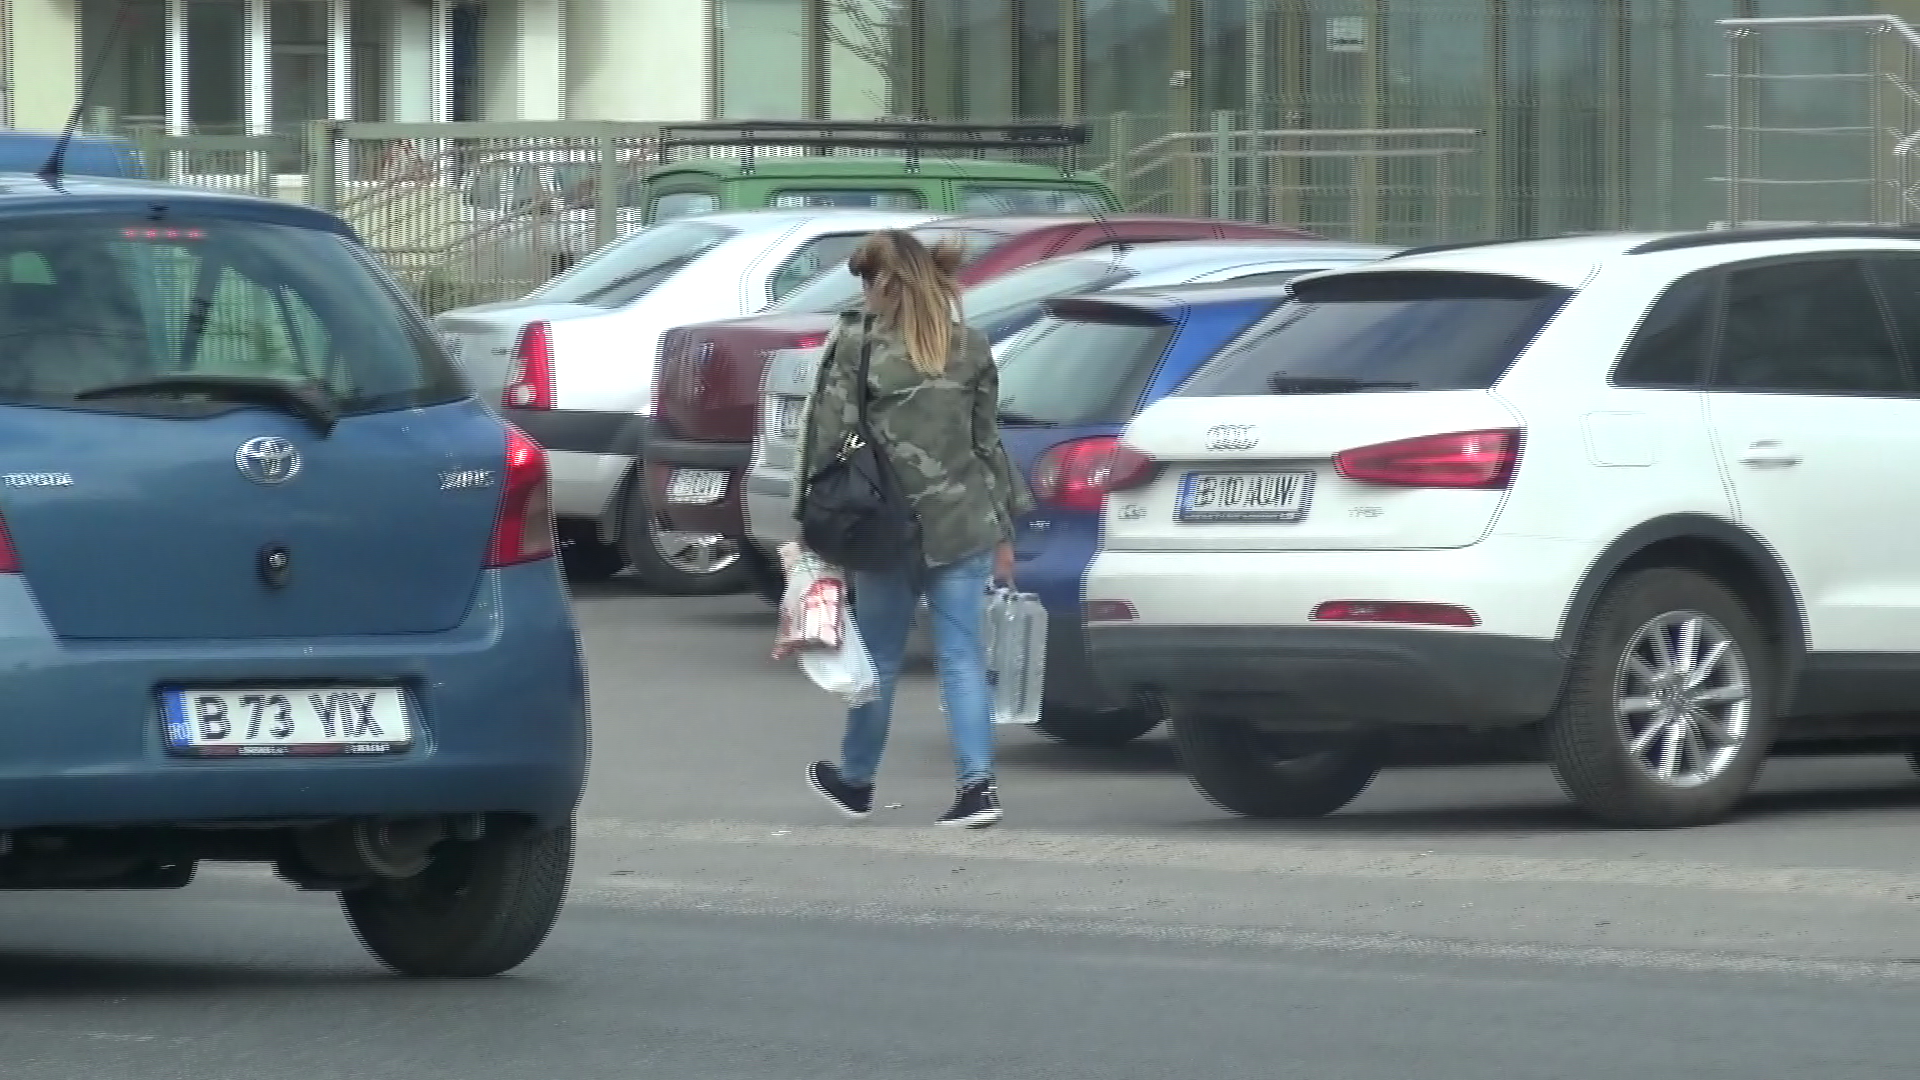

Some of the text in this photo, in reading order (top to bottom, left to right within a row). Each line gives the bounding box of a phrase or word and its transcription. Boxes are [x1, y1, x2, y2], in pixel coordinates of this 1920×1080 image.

[2, 473, 74, 487] TOYOTA
[438, 470, 495, 490] YARIS
[1194, 476, 1299, 507] B 10 AUW
[194, 692, 385, 739] B 73 YIX
